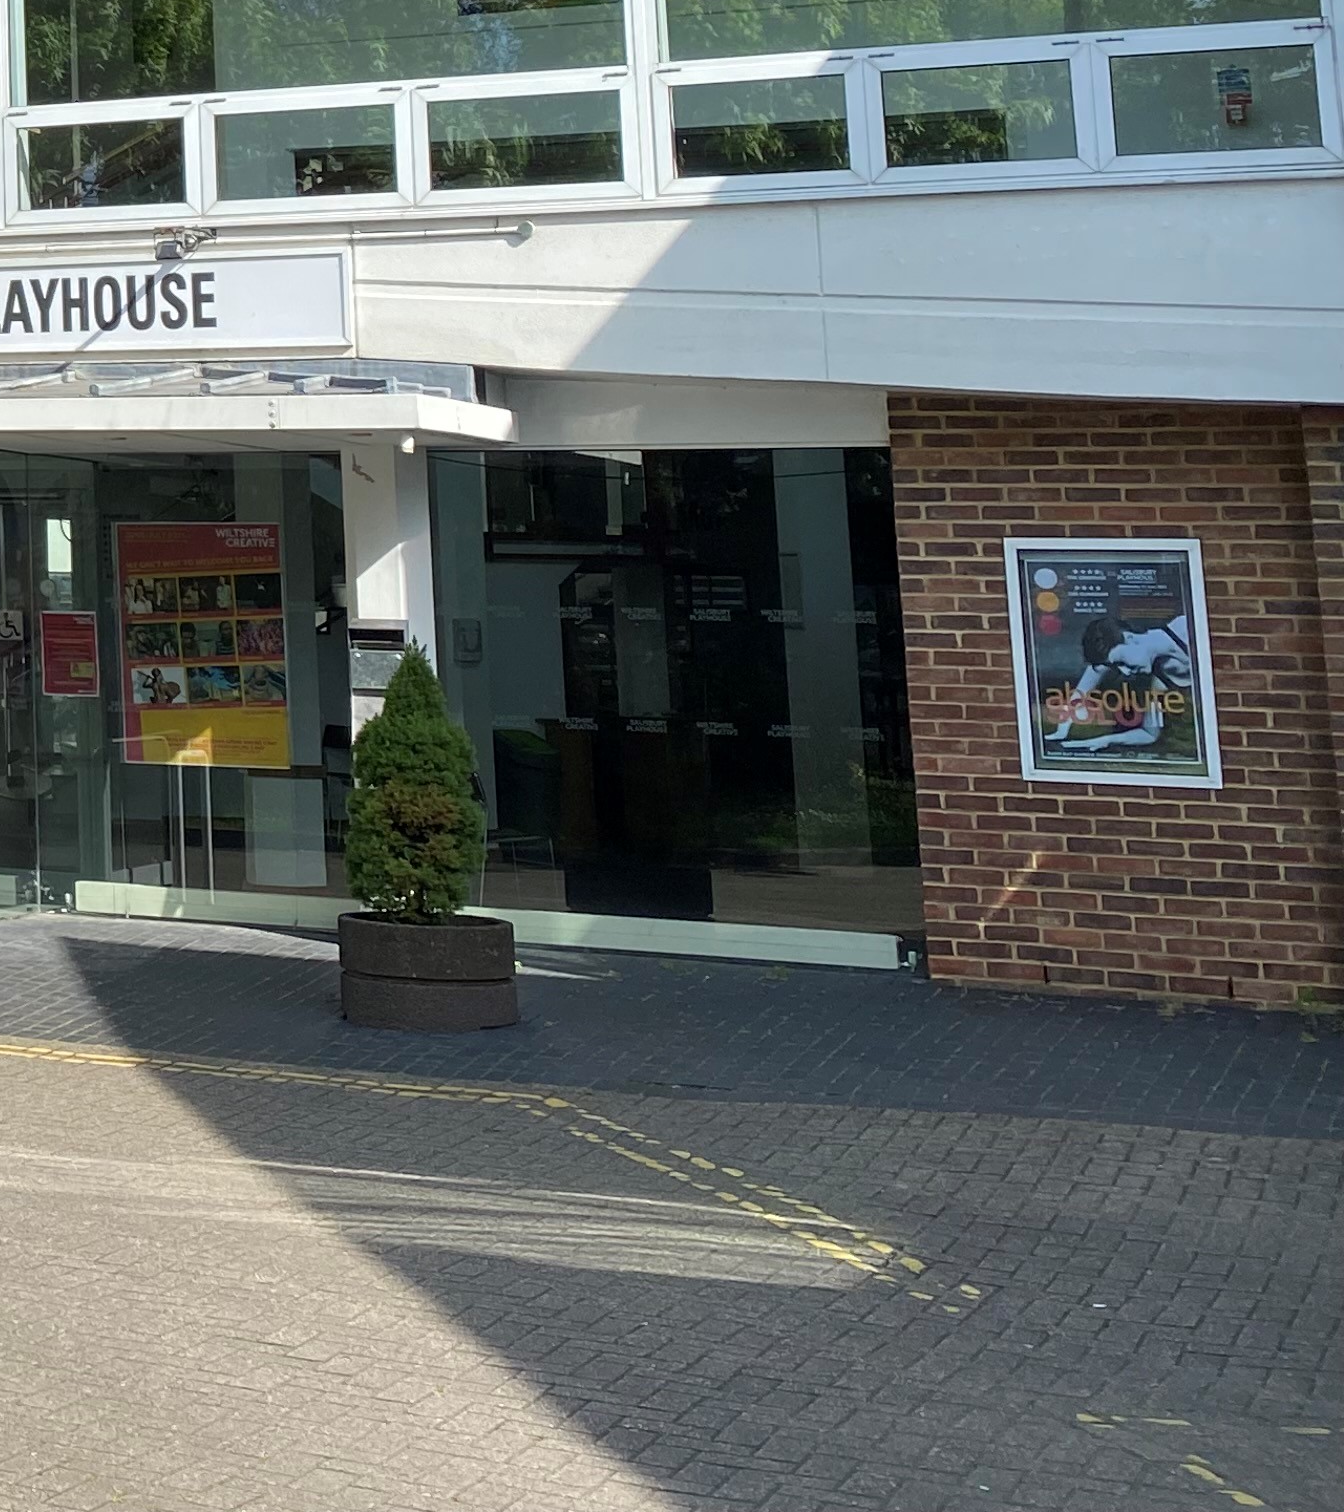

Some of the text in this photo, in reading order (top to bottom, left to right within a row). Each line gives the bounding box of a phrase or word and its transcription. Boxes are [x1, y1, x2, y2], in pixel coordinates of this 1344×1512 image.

[216, 528, 269, 538] WILTSHIRE
[226, 538, 275, 548] CREATIVE
[1045, 681, 1186, 715] absolute
